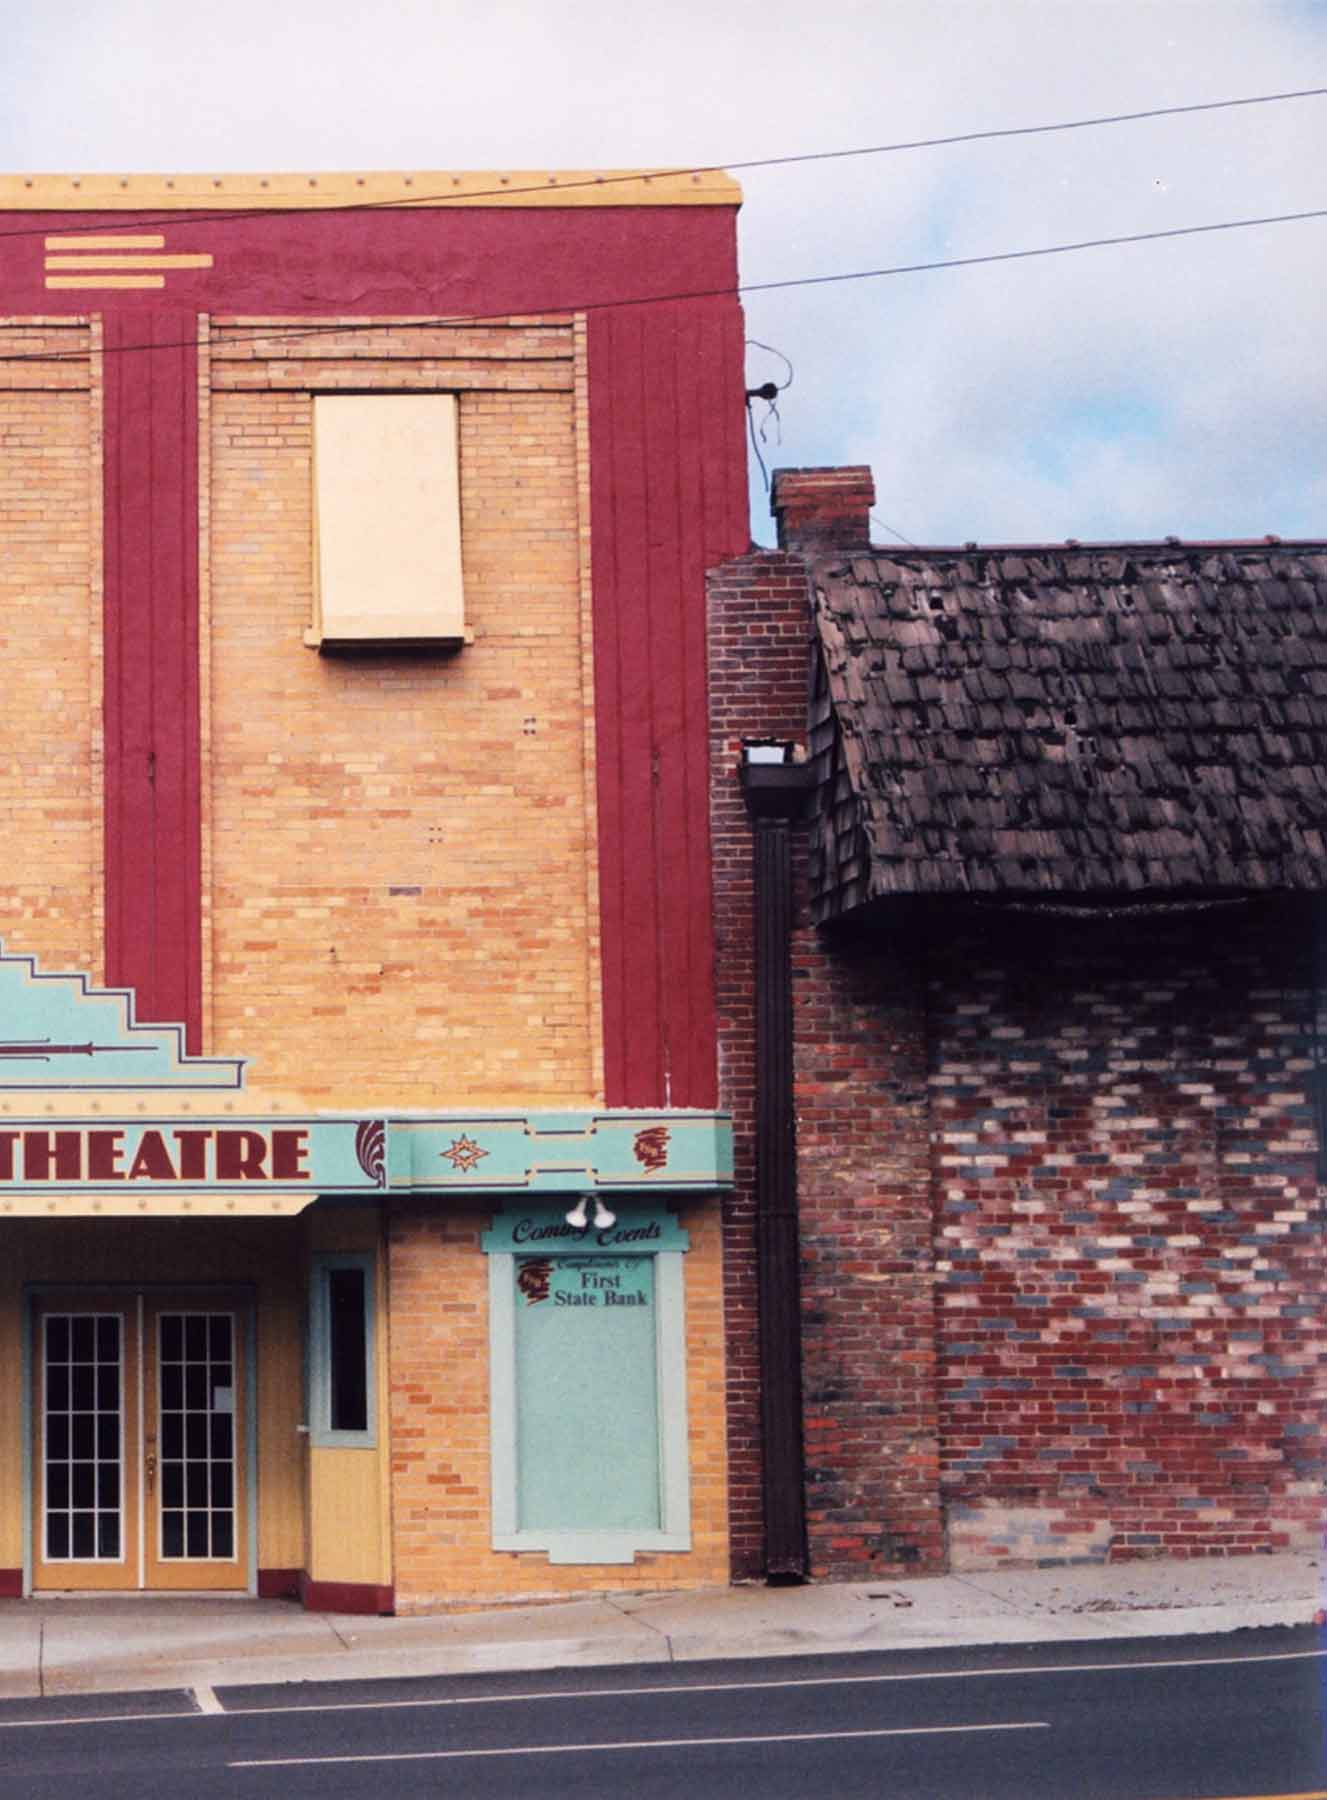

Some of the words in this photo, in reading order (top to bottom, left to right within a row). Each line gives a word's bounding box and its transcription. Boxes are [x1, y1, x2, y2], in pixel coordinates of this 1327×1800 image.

[512, 1217, 590, 1243] Coming
[596, 1221, 661, 1246] Events
[580, 1271, 622, 1289] First
[554, 1289, 597, 1306] State
[603, 1289, 648, 1306] Bank
